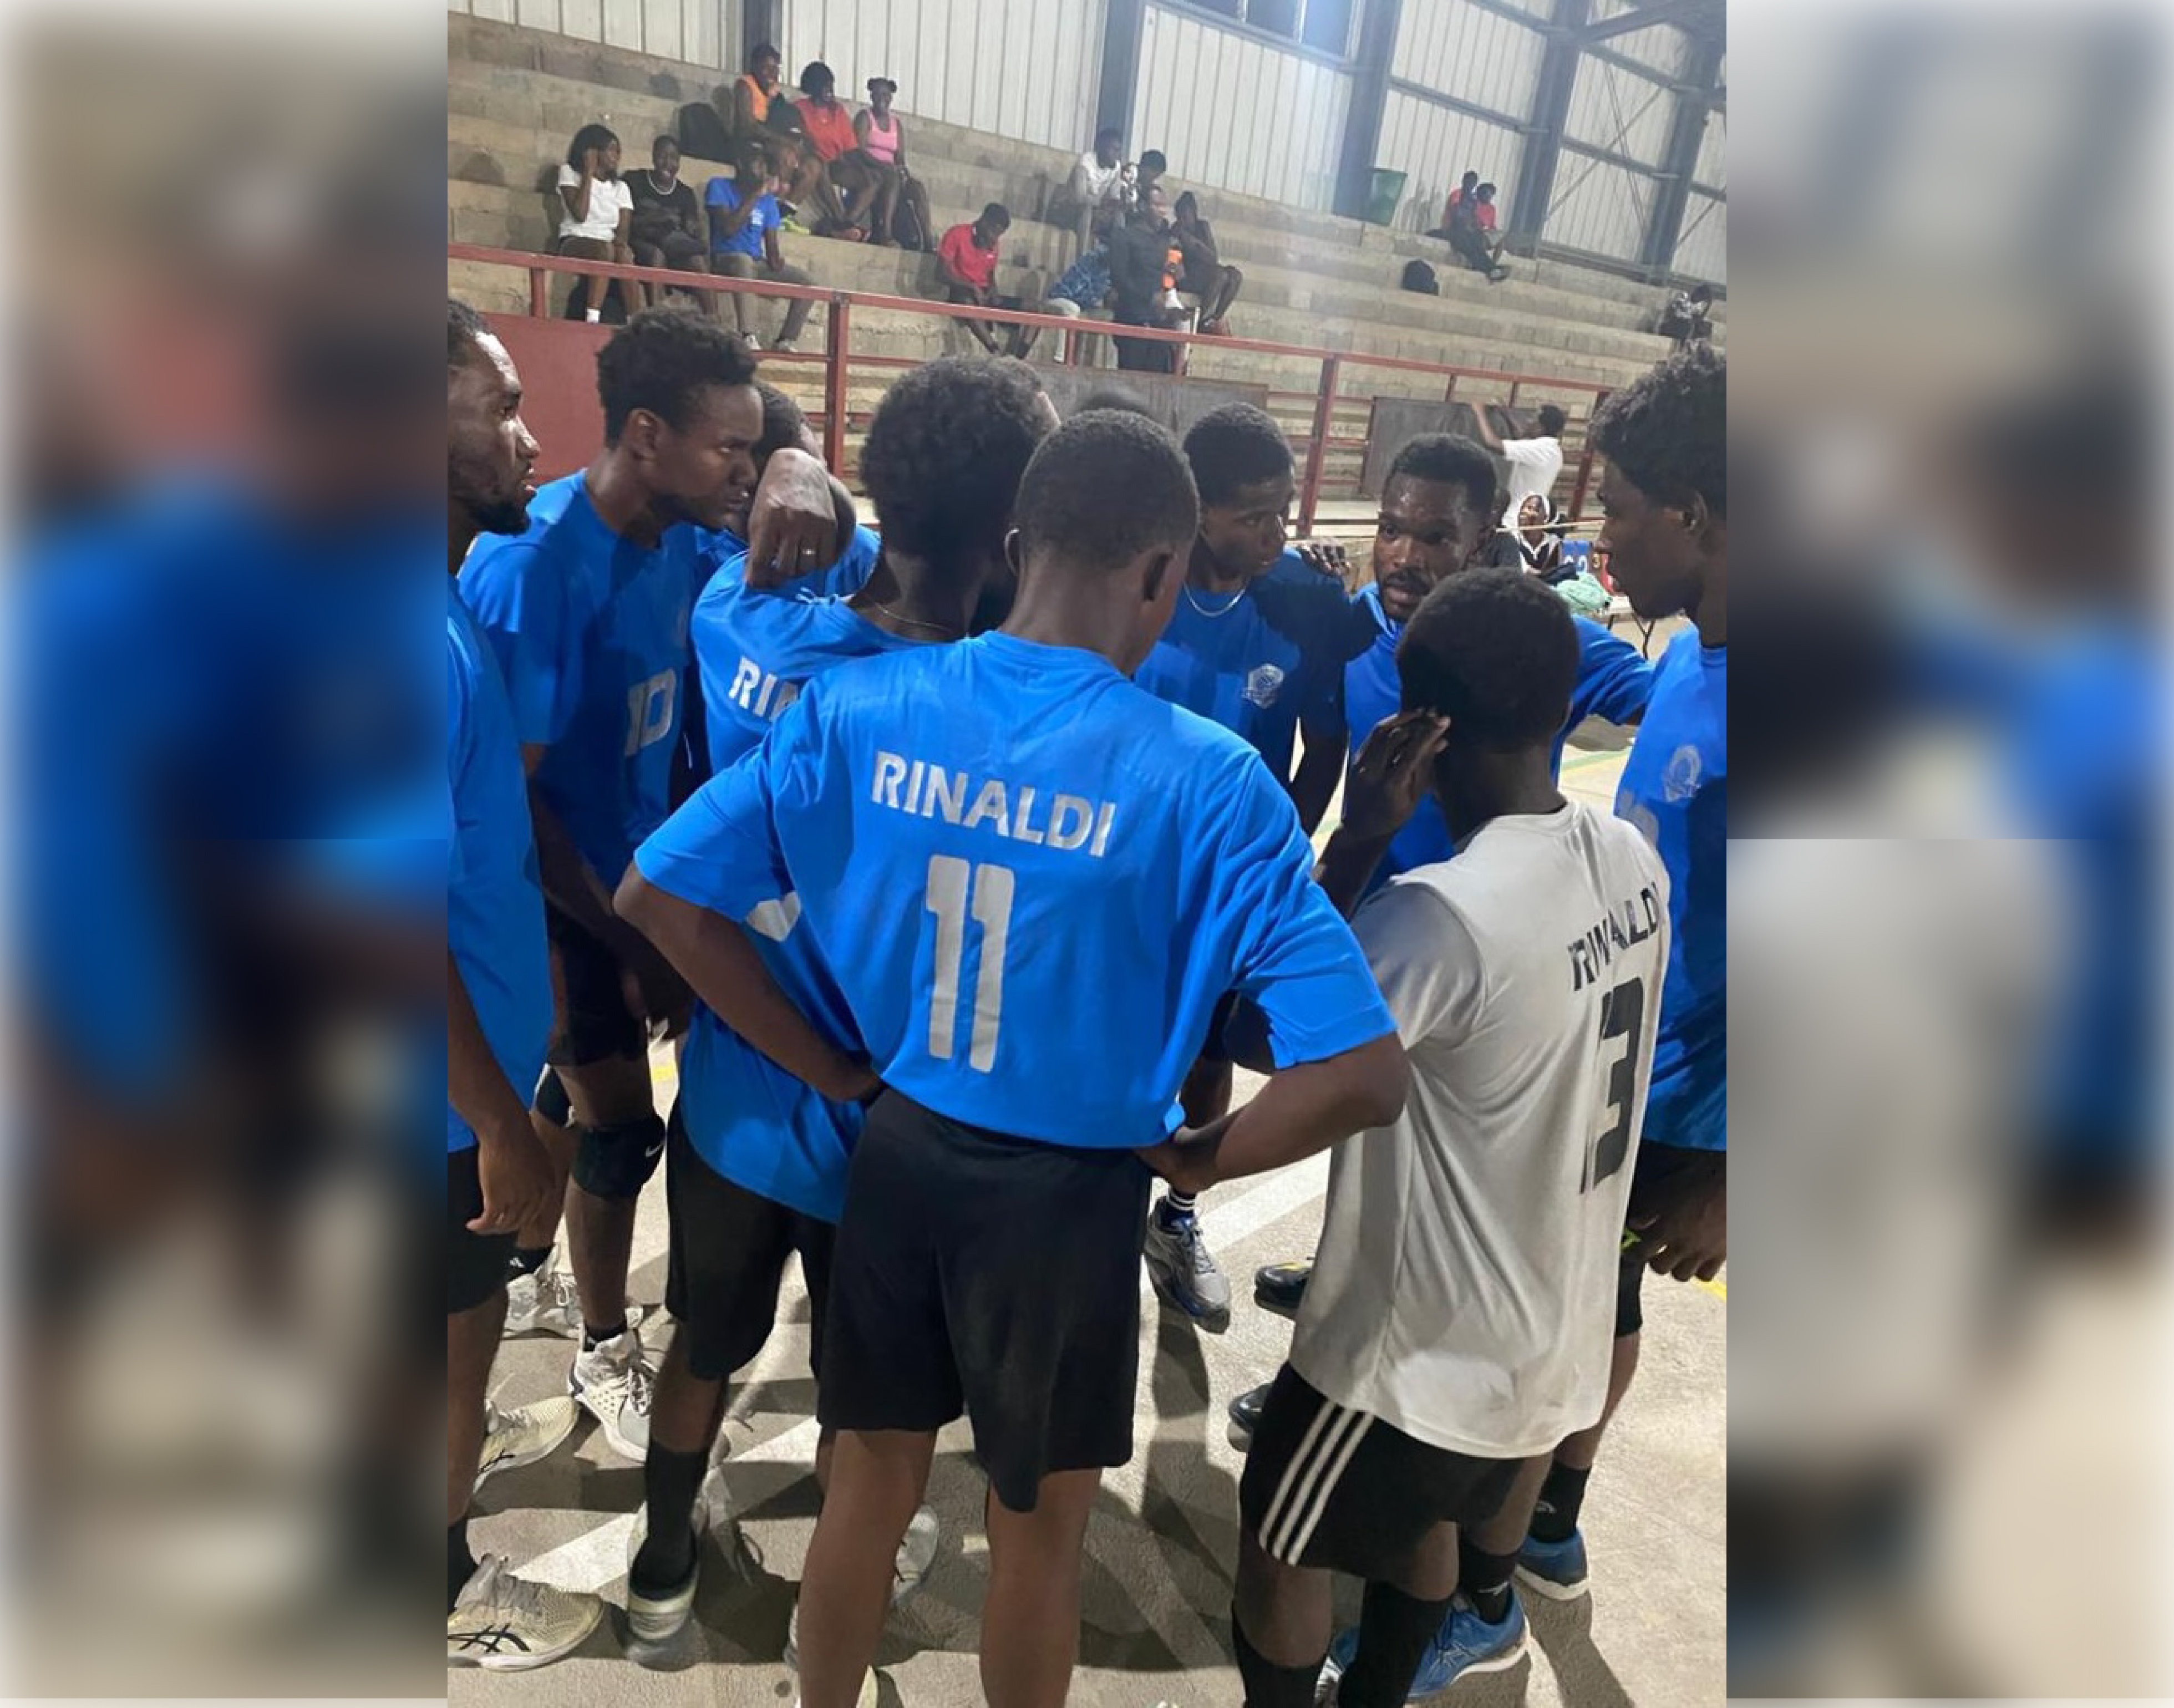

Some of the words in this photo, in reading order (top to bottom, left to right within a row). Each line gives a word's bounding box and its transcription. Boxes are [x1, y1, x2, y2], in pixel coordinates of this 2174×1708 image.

[871, 751, 1117, 857] RINALDI
[926, 854, 1015, 1073] 11
[1567, 881, 1661, 992] RINALD
